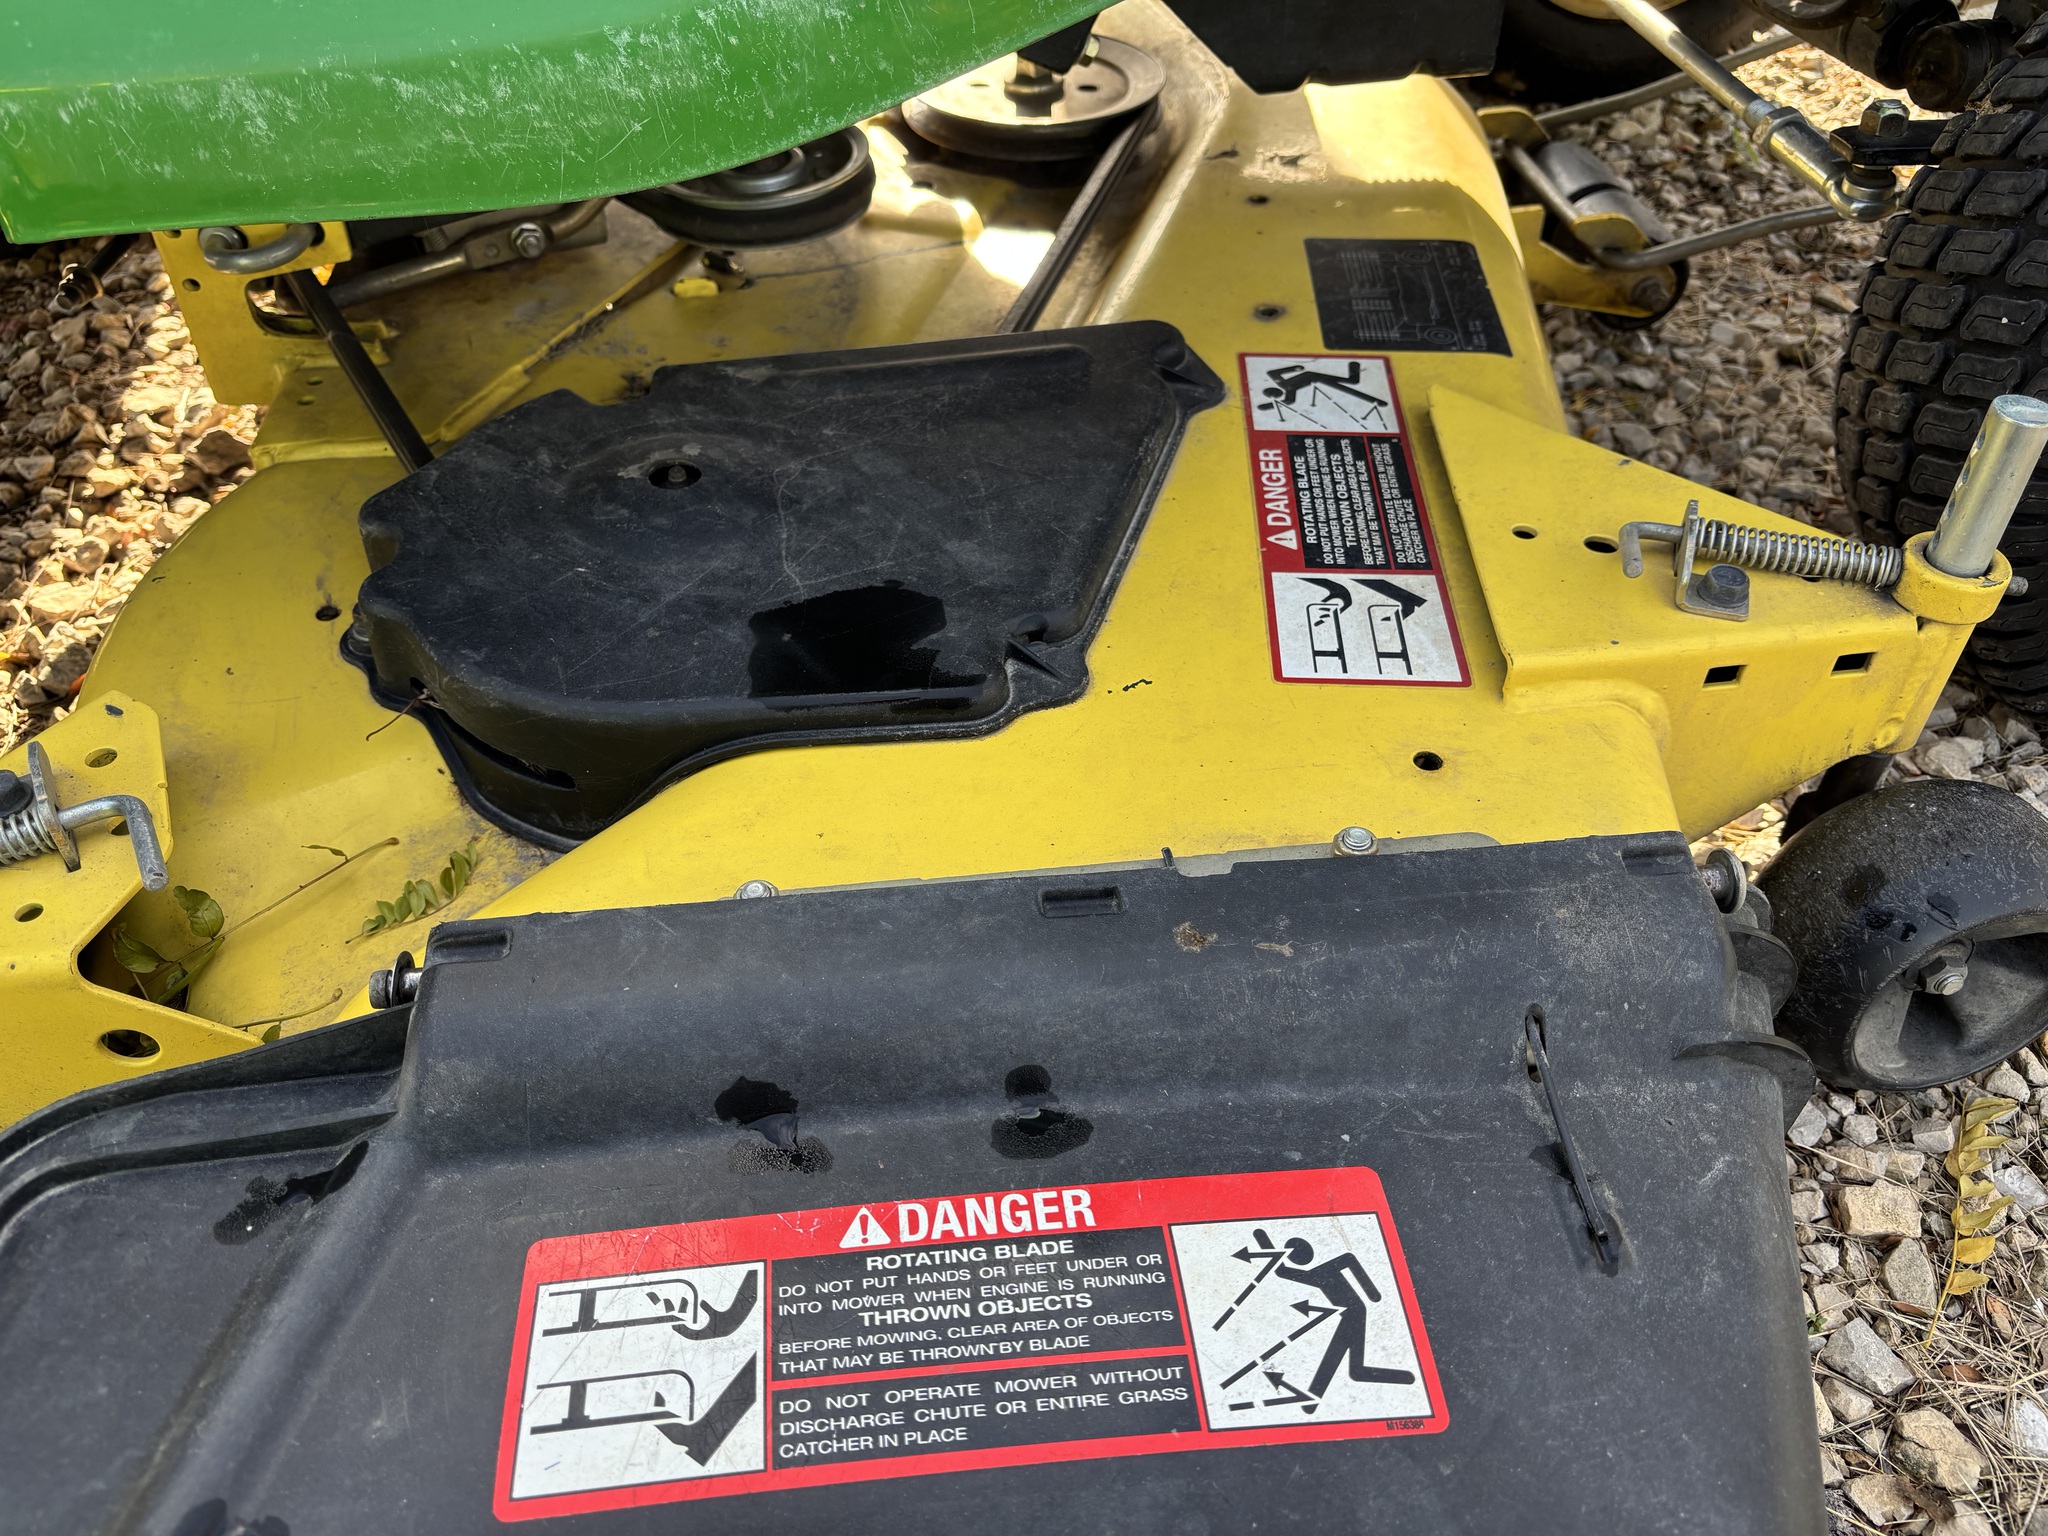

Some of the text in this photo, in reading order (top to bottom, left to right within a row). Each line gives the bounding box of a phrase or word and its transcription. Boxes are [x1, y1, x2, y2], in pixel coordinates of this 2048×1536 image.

[1315, 438, 1329, 466] RUNNING
[1341, 438, 1354, 465] OBJECTS
[1346, 465, 1356, 473] OF
[1259, 449, 1292, 526] DANGER
[1294, 456, 1318, 543] ROTATING BLADE
[1304, 438, 1334, 564] DO NOT PUT HANDS OR FEET UNDER OR
[1321, 474, 1334, 498] ENGINE
[1330, 453, 1358, 547] THROWN OBJECTS
[1347, 474, 1359, 489] AREA
[1350, 489, 1363, 510] CLEAR
[1326, 499, 1338, 519] WHEN
[1355, 460, 1386, 565] THAT MAY BE THROWN BY BLADE
[1371, 443, 1406, 563] DO NOT OPERATE MOWER WITHOUT
[1380, 443, 1416, 563] DISCHARGE CHUTE OR ENTIRE GRASS
[1330, 520, 1343, 546] MOWER
[1360, 538, 1374, 564] BEFORE
[1403, 499, 1426, 563] CATCHER IN PLACE
[1334, 547, 1346, 564] INTO
[898, 1189, 1097, 1243] DANGER
[866, 1239, 1075, 1271] ROTATING BLADE
[779, 1254, 1162, 1298] DO NOT PUT HANDS OR FEET UNDER OR
[779, 1272, 1166, 1316] INTO MOWER WHEN ENGINE IS RUNNING
[858, 1293, 1093, 1326] THROWN OBJECTS
[779, 1310, 1174, 1355] BEFORE MOWING, CLEAR AREA OF OBJECTS
[778, 1335, 1090, 1374] THAT MAY BE THROWN BY BLADE
[779, 1367, 1184, 1414] DO NOT OPERATE MOWER WITHOUT
[780, 1388, 1189, 1436] DISCHARGE CHUTE OR ENTIRE GRASS
[779, 1427, 968, 1458] CATCHER IN PLACE
